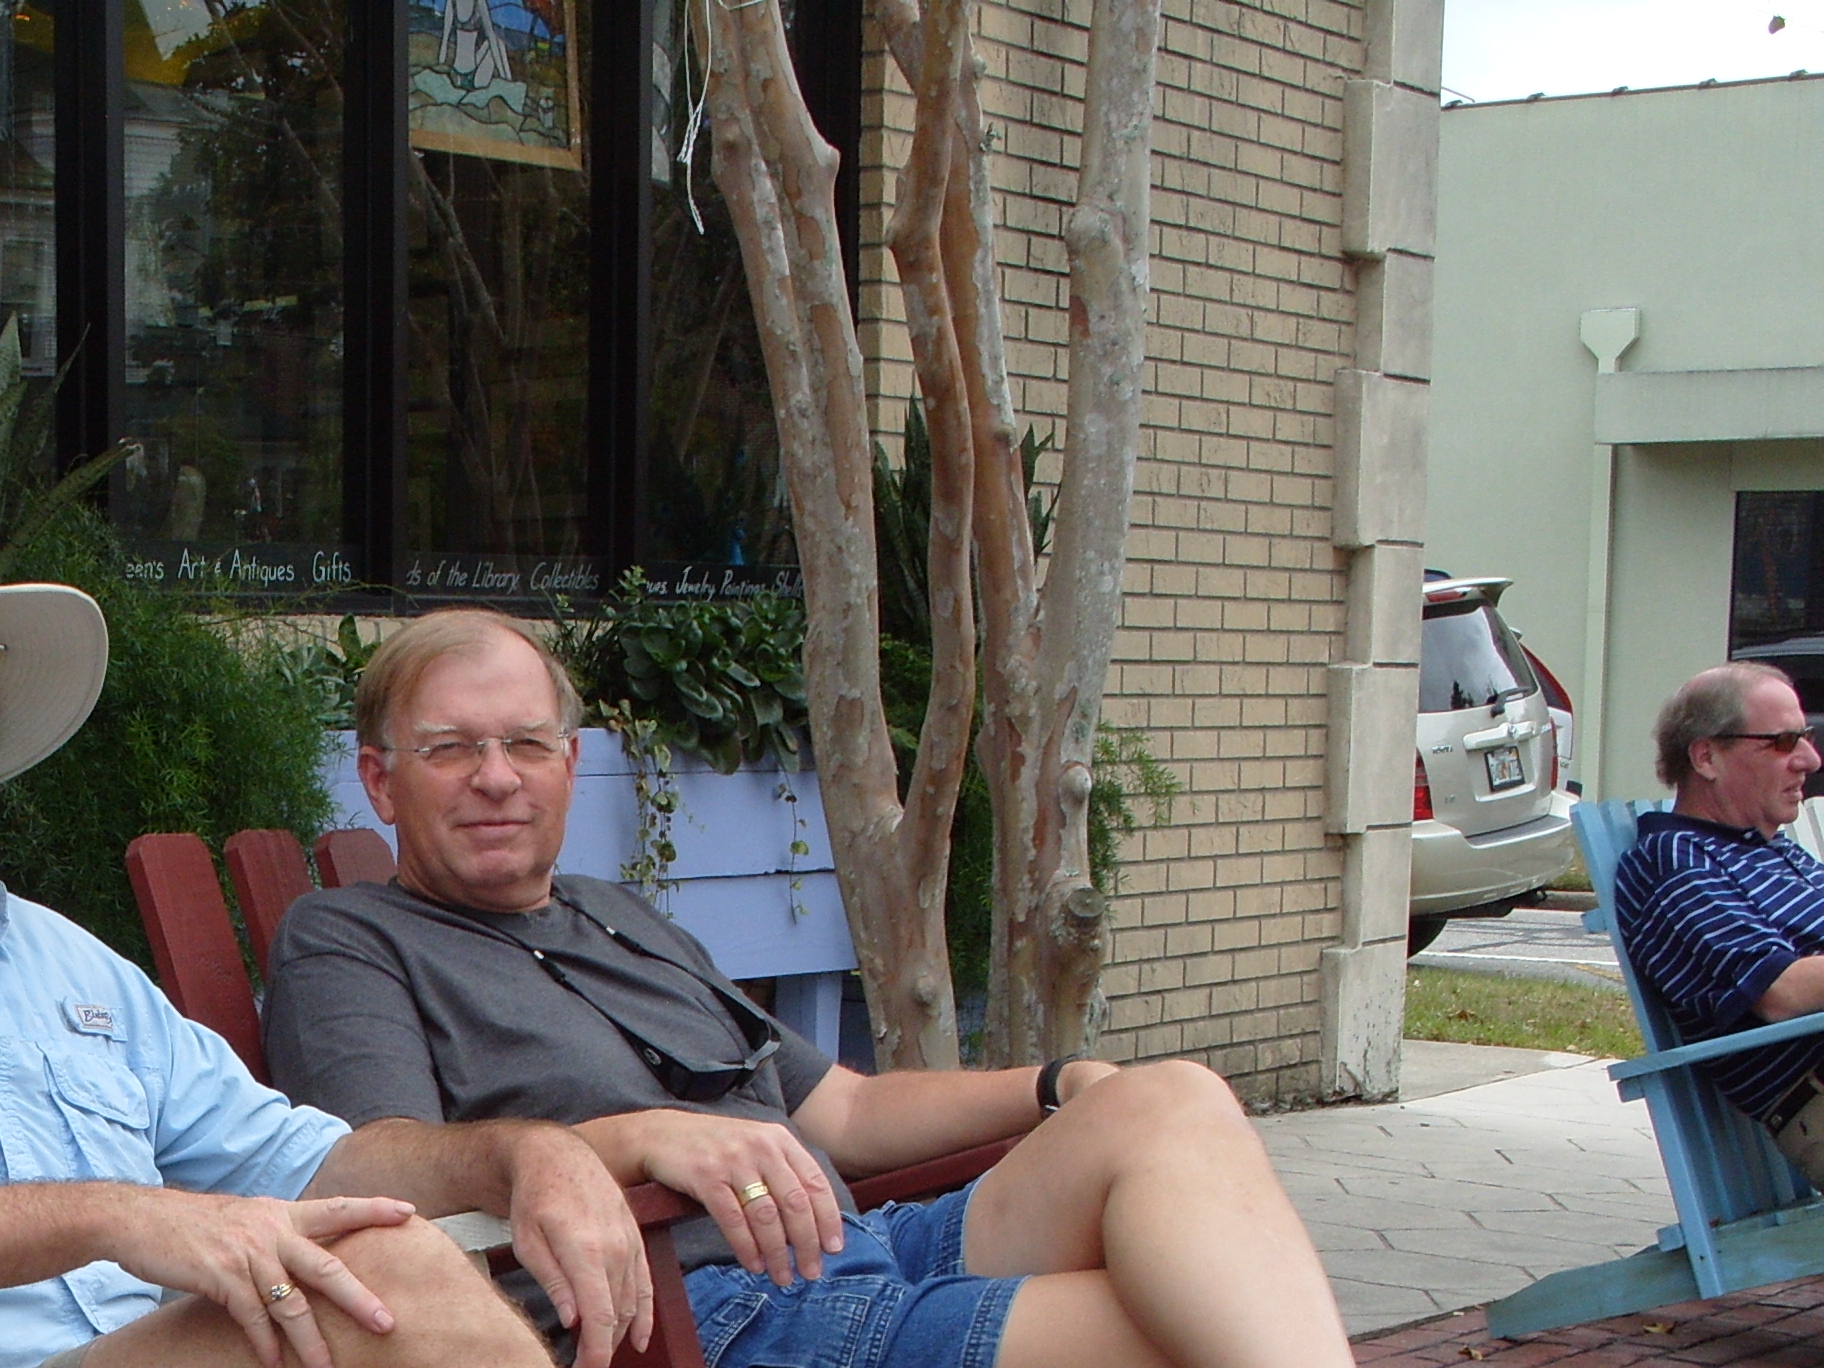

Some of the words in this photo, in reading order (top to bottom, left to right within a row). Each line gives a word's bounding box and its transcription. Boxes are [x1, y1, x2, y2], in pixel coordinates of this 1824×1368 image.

[177, 547, 206, 579] Art
[229, 547, 295, 588] Antiques
[312, 550, 352, 583] Gifts
[426, 559, 447, 587] of
[446, 560, 469, 587] the
[529, 561, 600, 591] Collectibles
